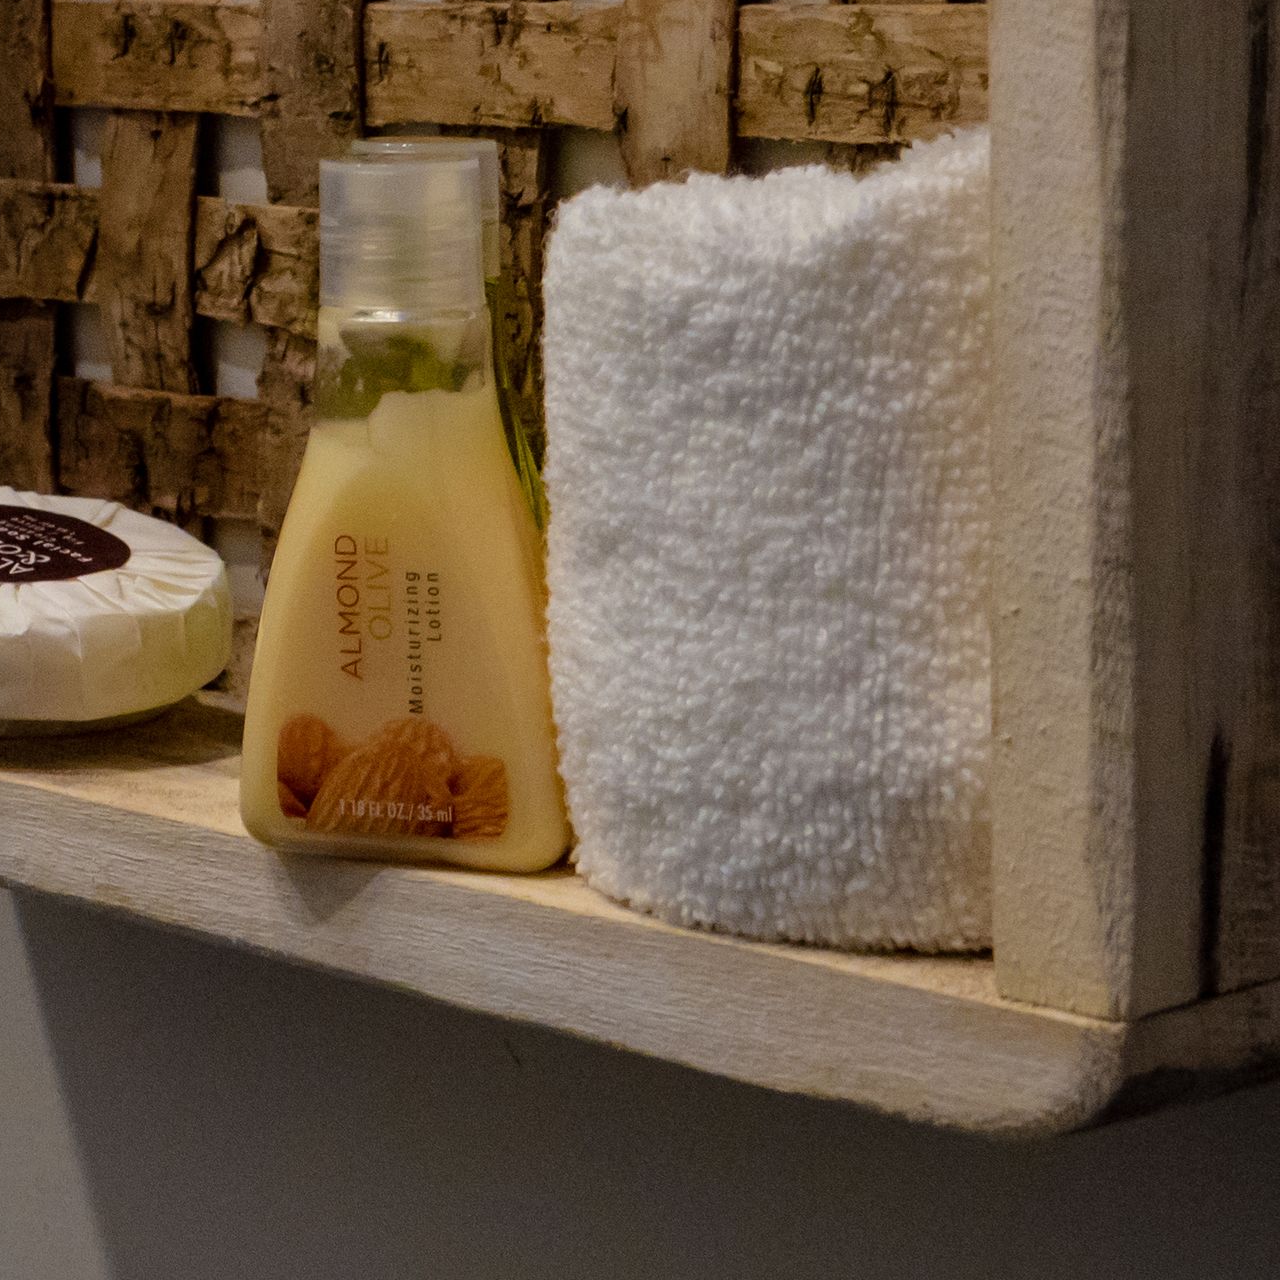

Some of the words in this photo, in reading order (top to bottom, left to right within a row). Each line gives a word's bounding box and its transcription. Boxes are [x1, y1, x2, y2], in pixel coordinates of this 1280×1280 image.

[334, 535, 363, 681] ALMOND
[364, 536, 393, 641] OLIVE
[426, 572, 442, 642] Lotion
[405, 572, 423, 714] Moisturizing
[417, 803, 433, 821] 35
[437, 805, 452, 822] ml
